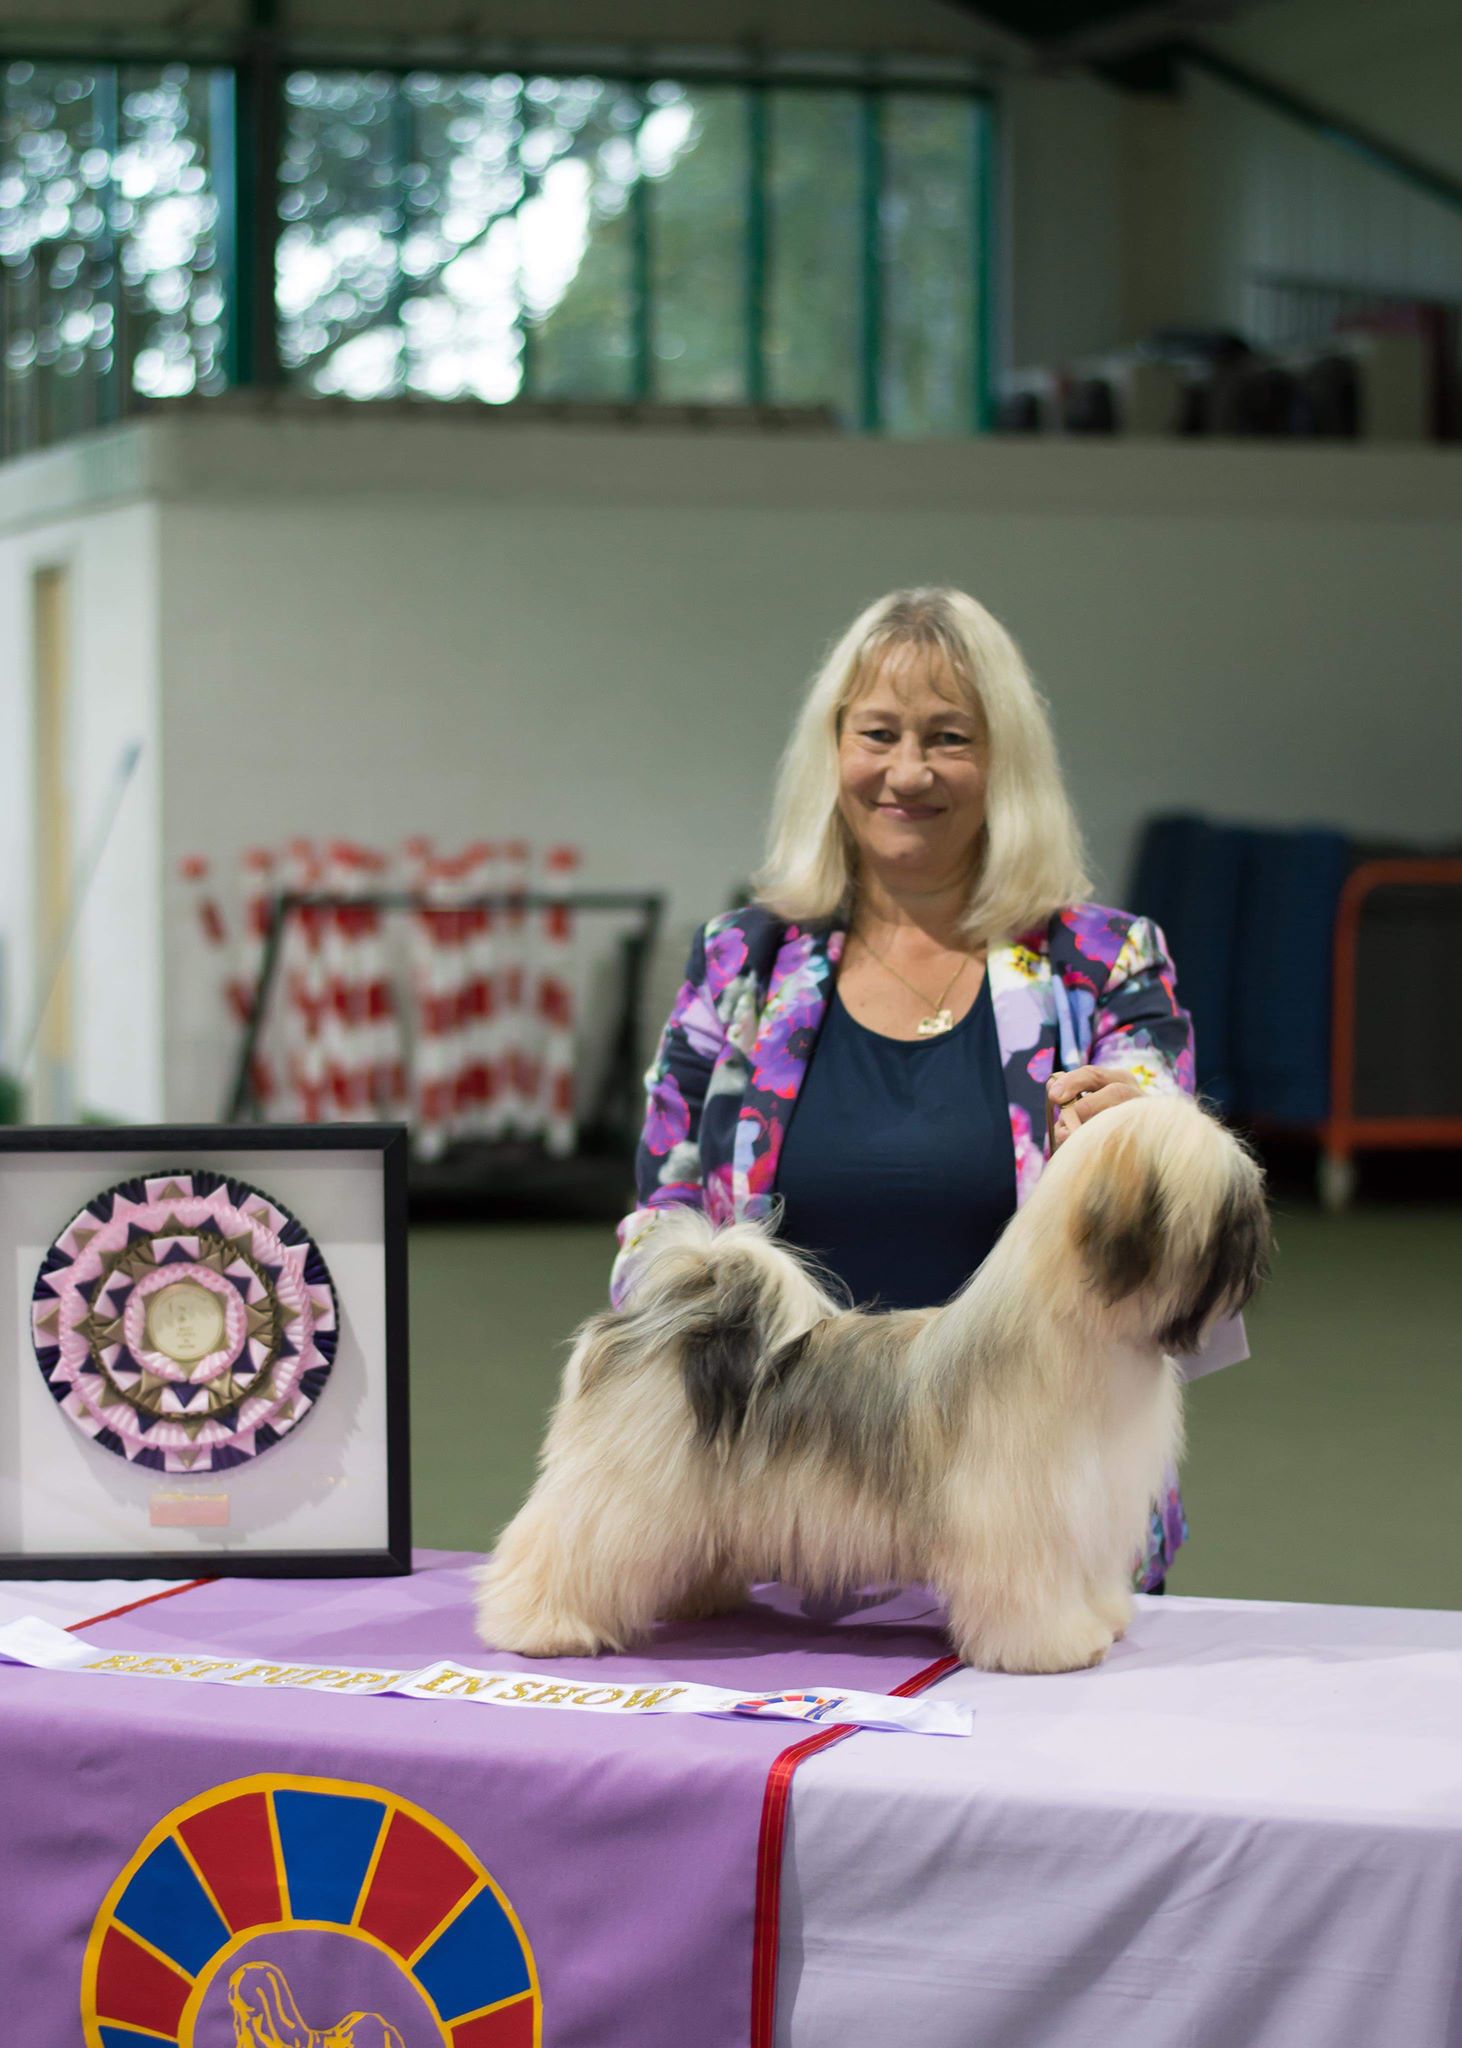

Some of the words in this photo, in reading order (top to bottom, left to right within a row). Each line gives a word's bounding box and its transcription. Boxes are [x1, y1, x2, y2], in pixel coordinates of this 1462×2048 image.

[81, 1655, 237, 1676] BEST
[417, 1670, 505, 1695] IN
[497, 1681, 688, 1708] SHOW
